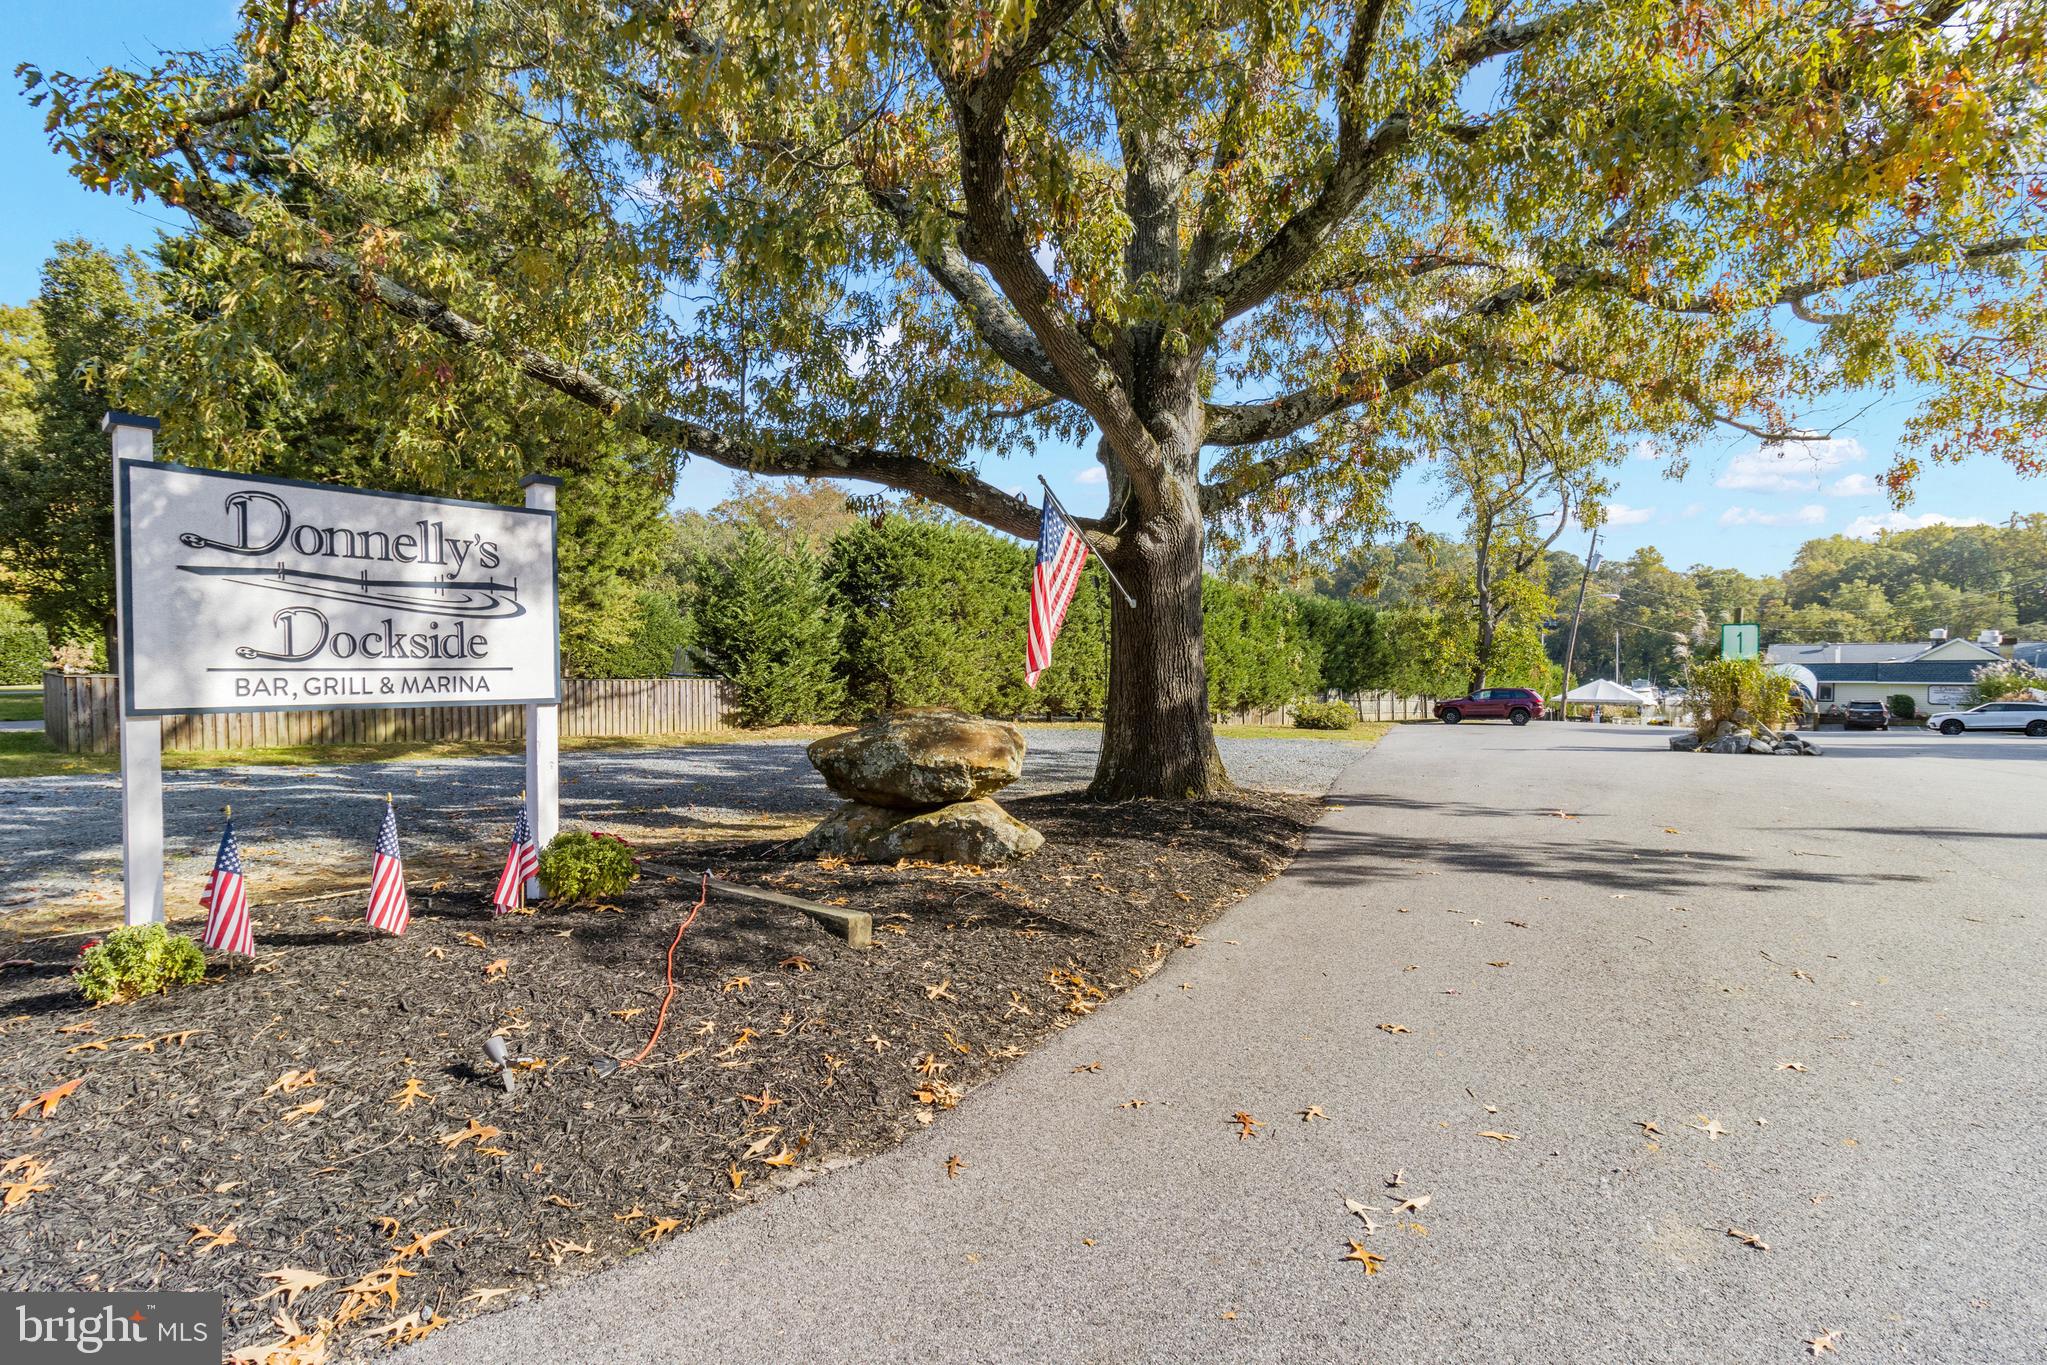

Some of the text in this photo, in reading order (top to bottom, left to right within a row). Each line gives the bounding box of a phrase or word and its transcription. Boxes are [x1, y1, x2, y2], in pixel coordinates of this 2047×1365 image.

[180, 490, 501, 579] Donnelly's
[236, 606, 488, 663] Dockside
[1736, 631, 1743, 654] 1
[235, 675, 490, 700] BAR, GRILL & MARINA
